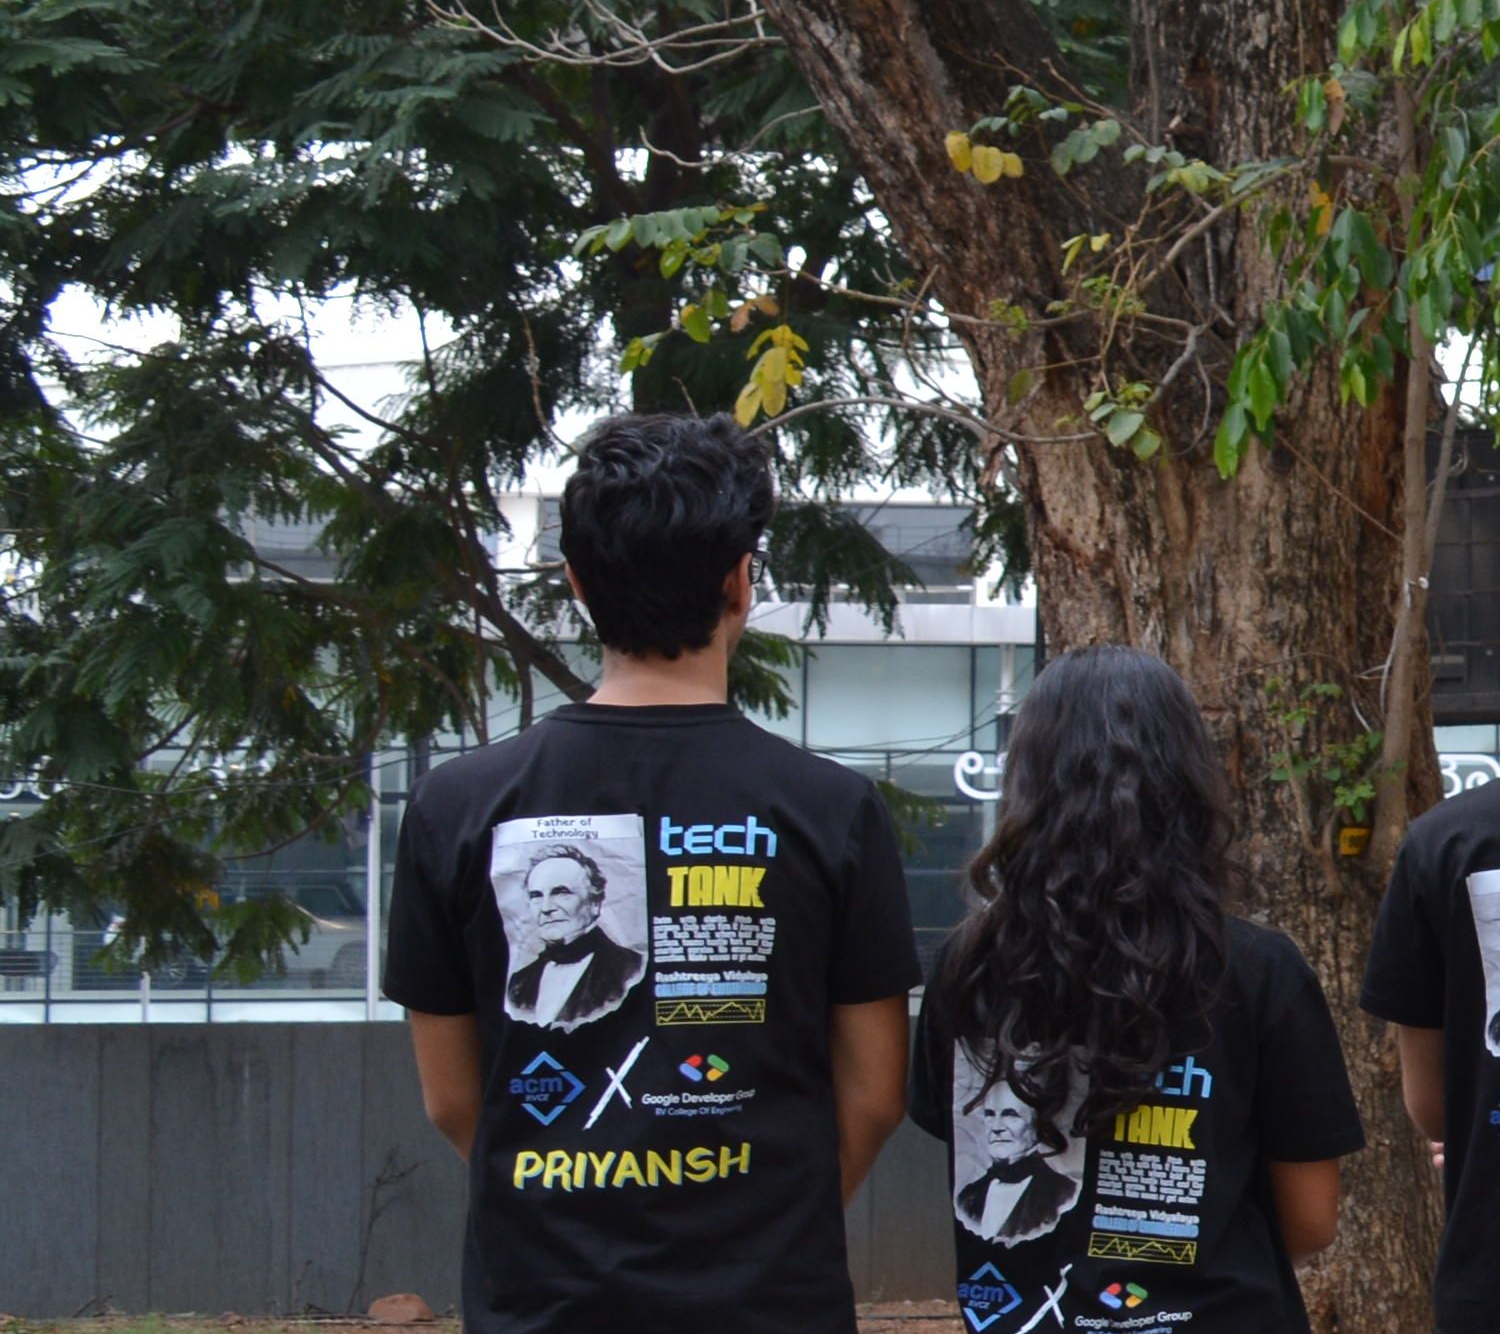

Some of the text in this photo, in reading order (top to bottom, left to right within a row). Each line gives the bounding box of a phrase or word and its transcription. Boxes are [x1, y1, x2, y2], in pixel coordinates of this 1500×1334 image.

[537, 818, 592, 827] Father of
[532, 829, 598, 839] Technology
[659, 816, 777, 857] tech
[667, 866, 766, 907] TANK
[509, 1076, 563, 1094] acm
[1155, 1056, 1212, 1098] ch
[641, 1092, 735, 1105] Google Developer
[513, 1142, 751, 1192] PRIYANSH
[1074, 1310, 1192, 1328] Google Group
